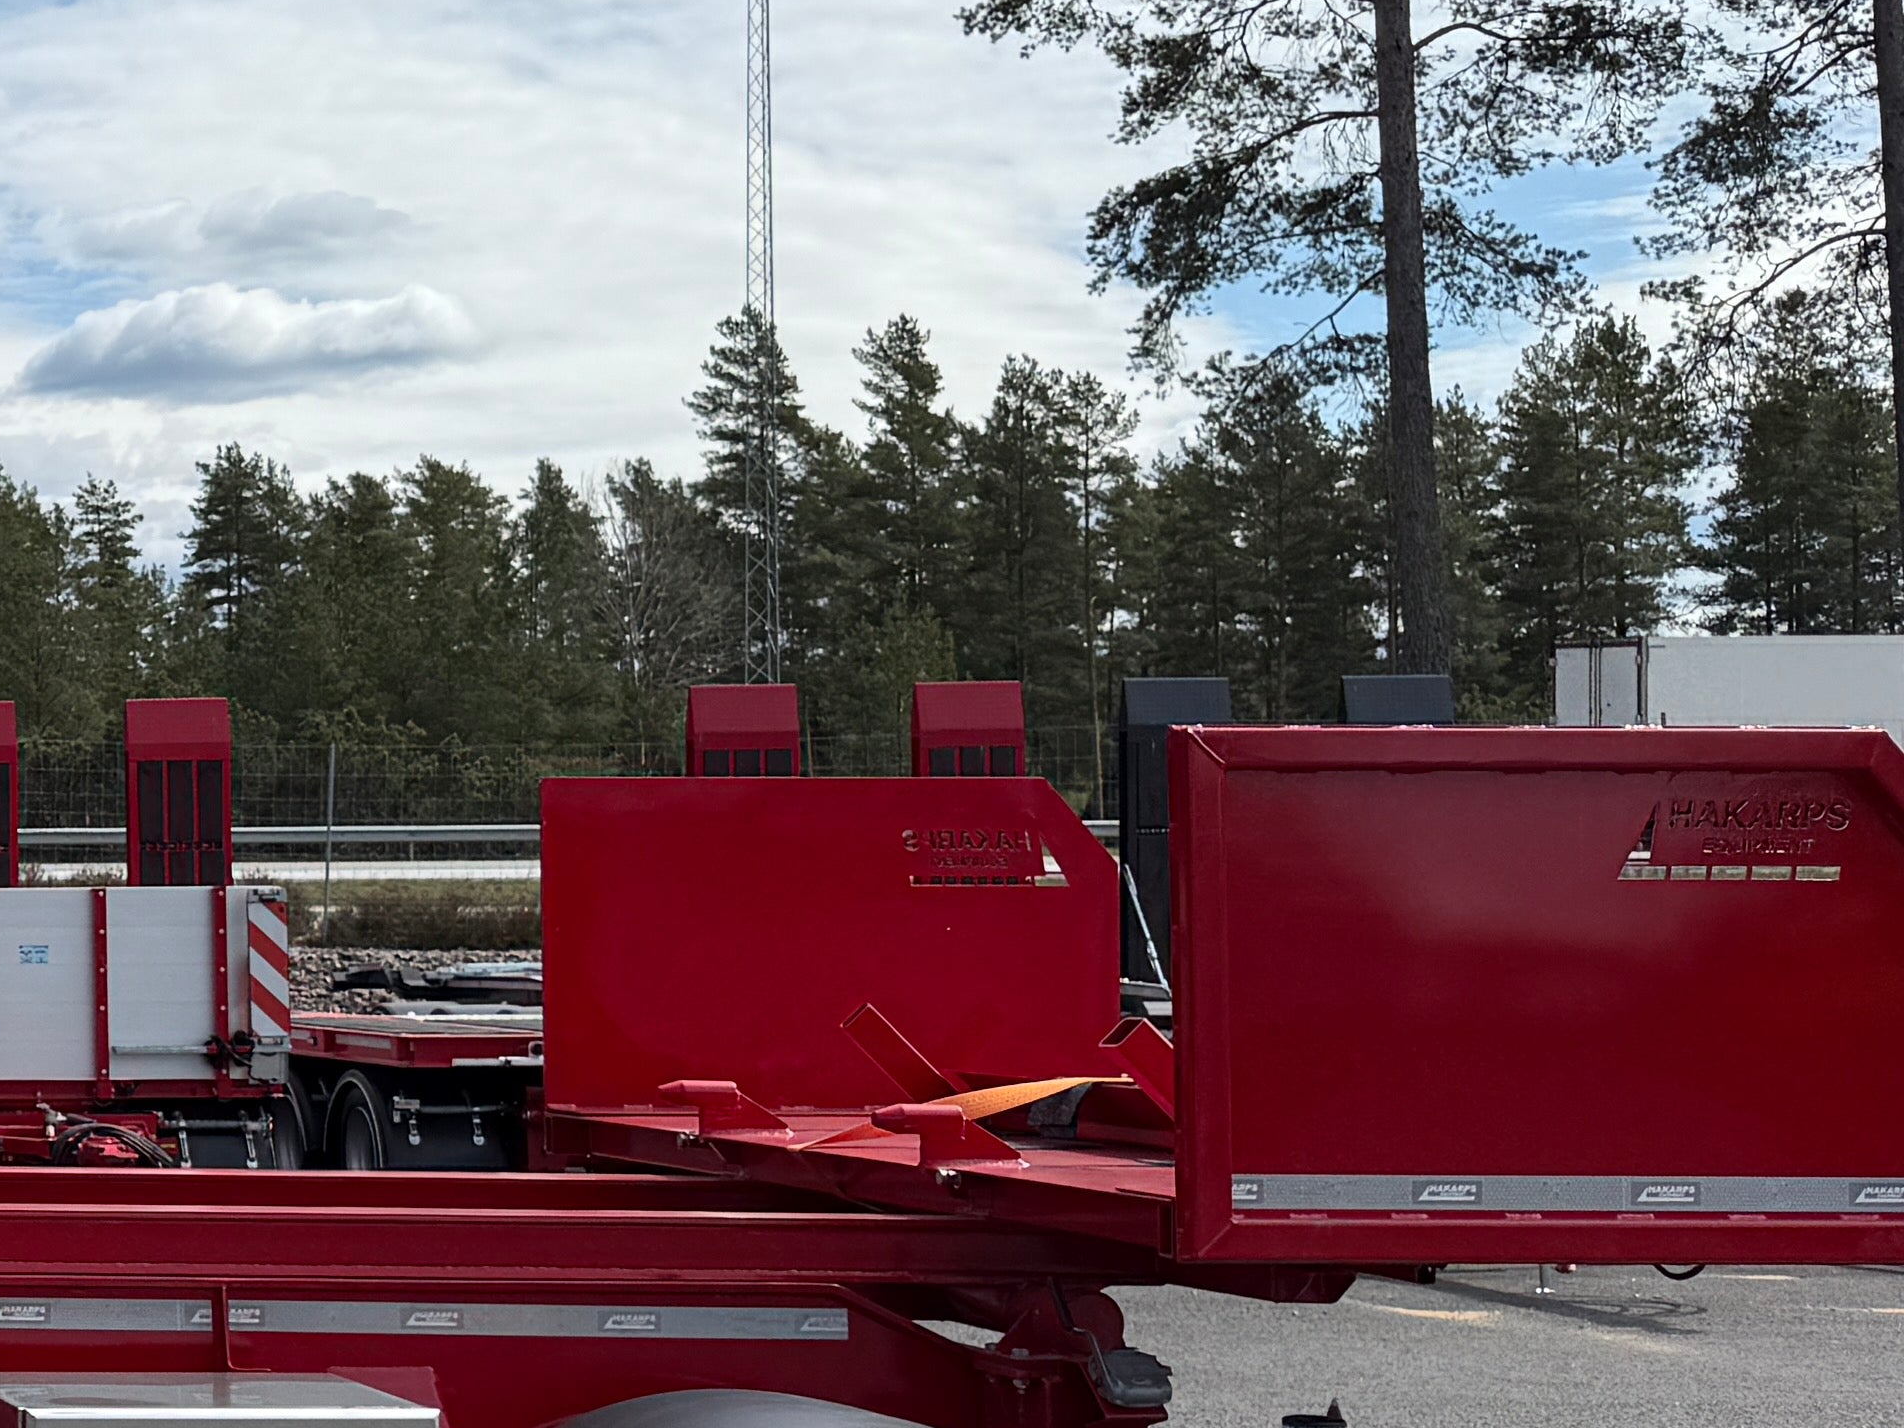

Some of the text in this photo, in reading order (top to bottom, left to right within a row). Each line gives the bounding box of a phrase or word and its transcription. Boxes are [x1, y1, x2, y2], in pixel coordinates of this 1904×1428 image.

[1668, 798, 1853, 832] HAKARPS
[1701, 836, 1816, 854] EQUIPMENT
[1428, 1184, 1477, 1194] HAKARPS
[1647, 1185, 1696, 1195] HAKARPS
